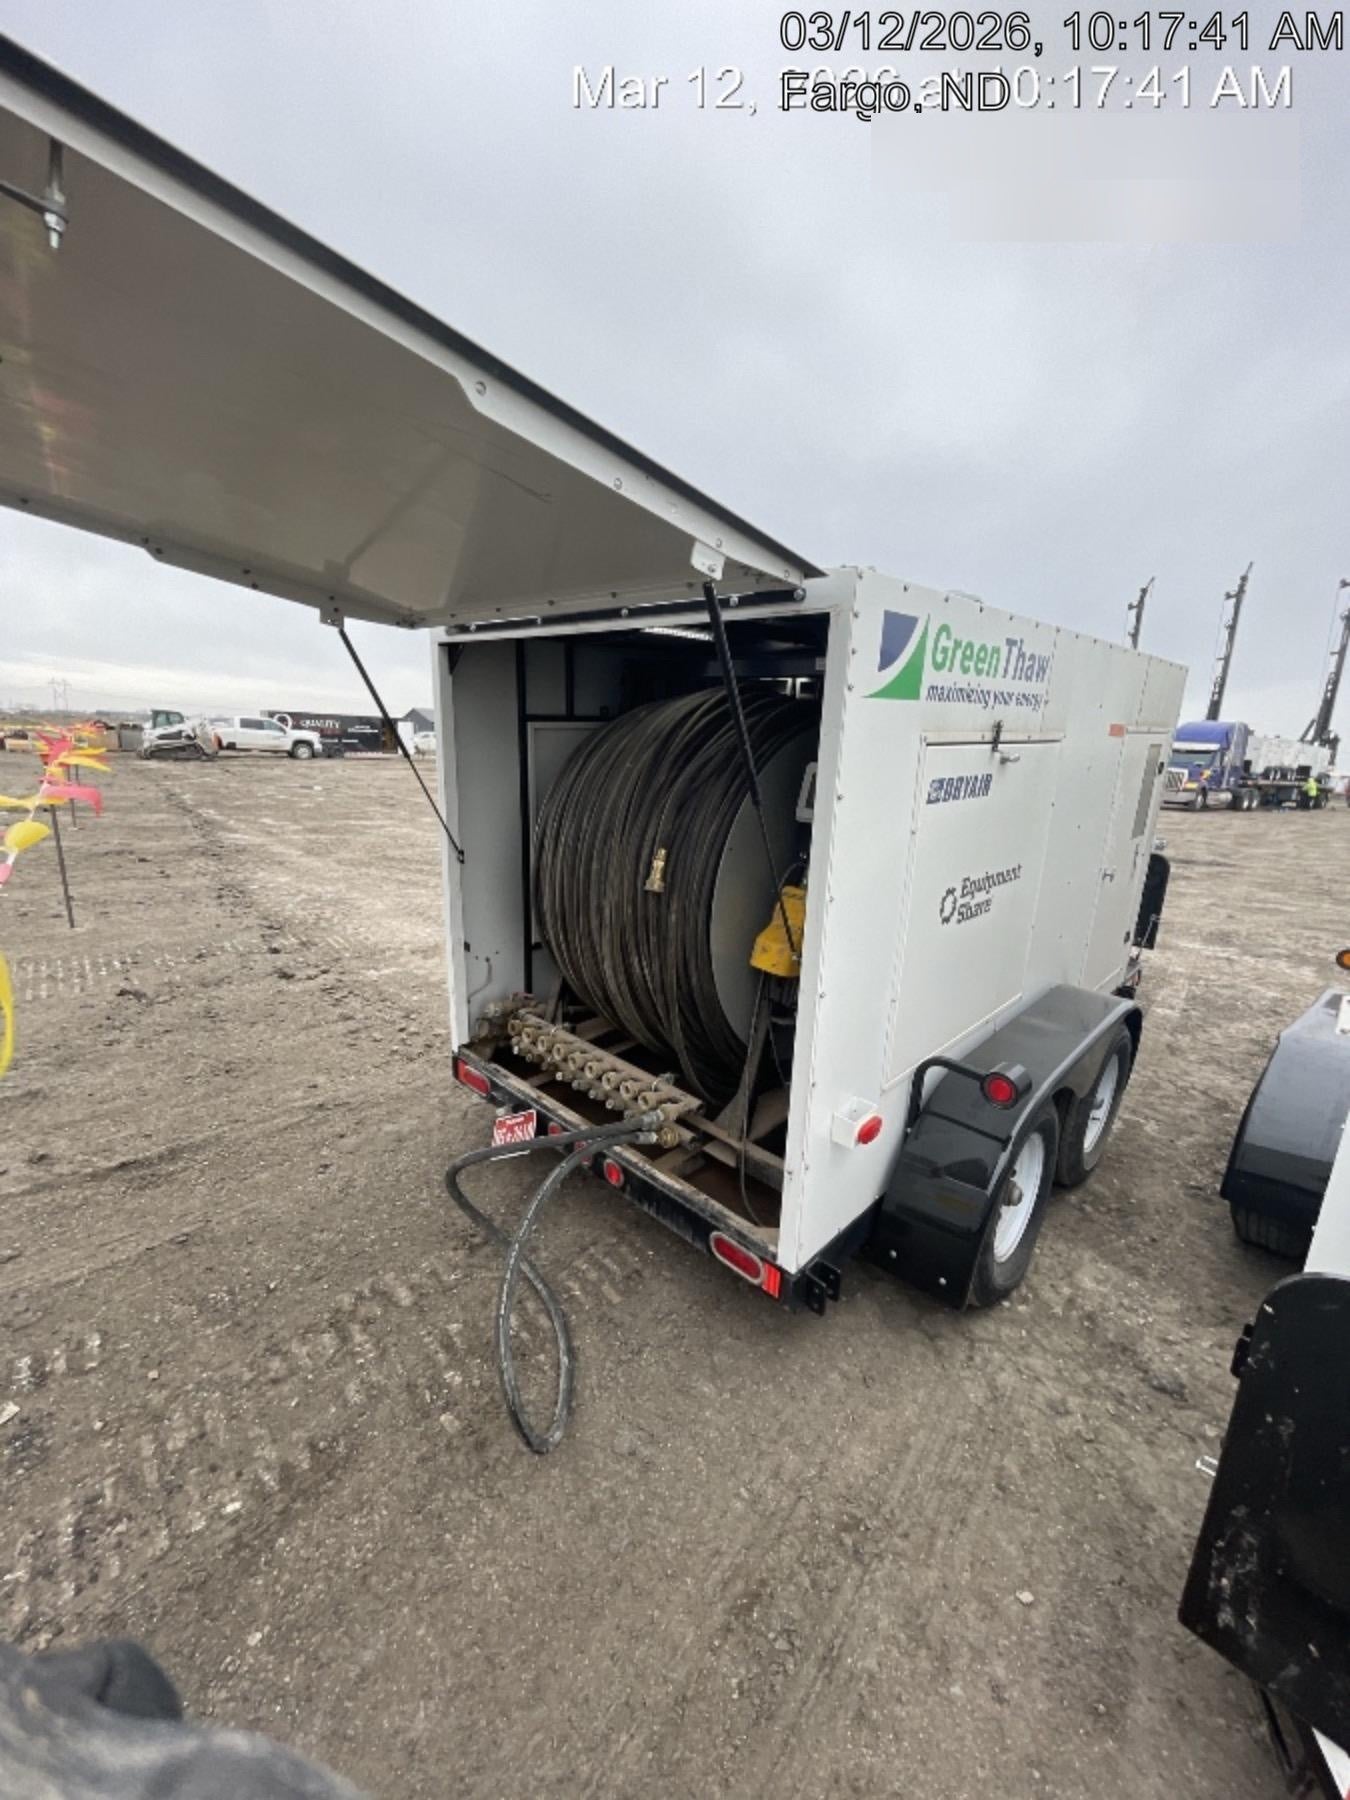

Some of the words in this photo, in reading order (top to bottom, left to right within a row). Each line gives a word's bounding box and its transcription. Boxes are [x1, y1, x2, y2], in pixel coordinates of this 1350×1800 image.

[991, 688, 1015, 711] your
[960, 864, 1023, 901] Equipment
[956, 897, 993, 925] Share
